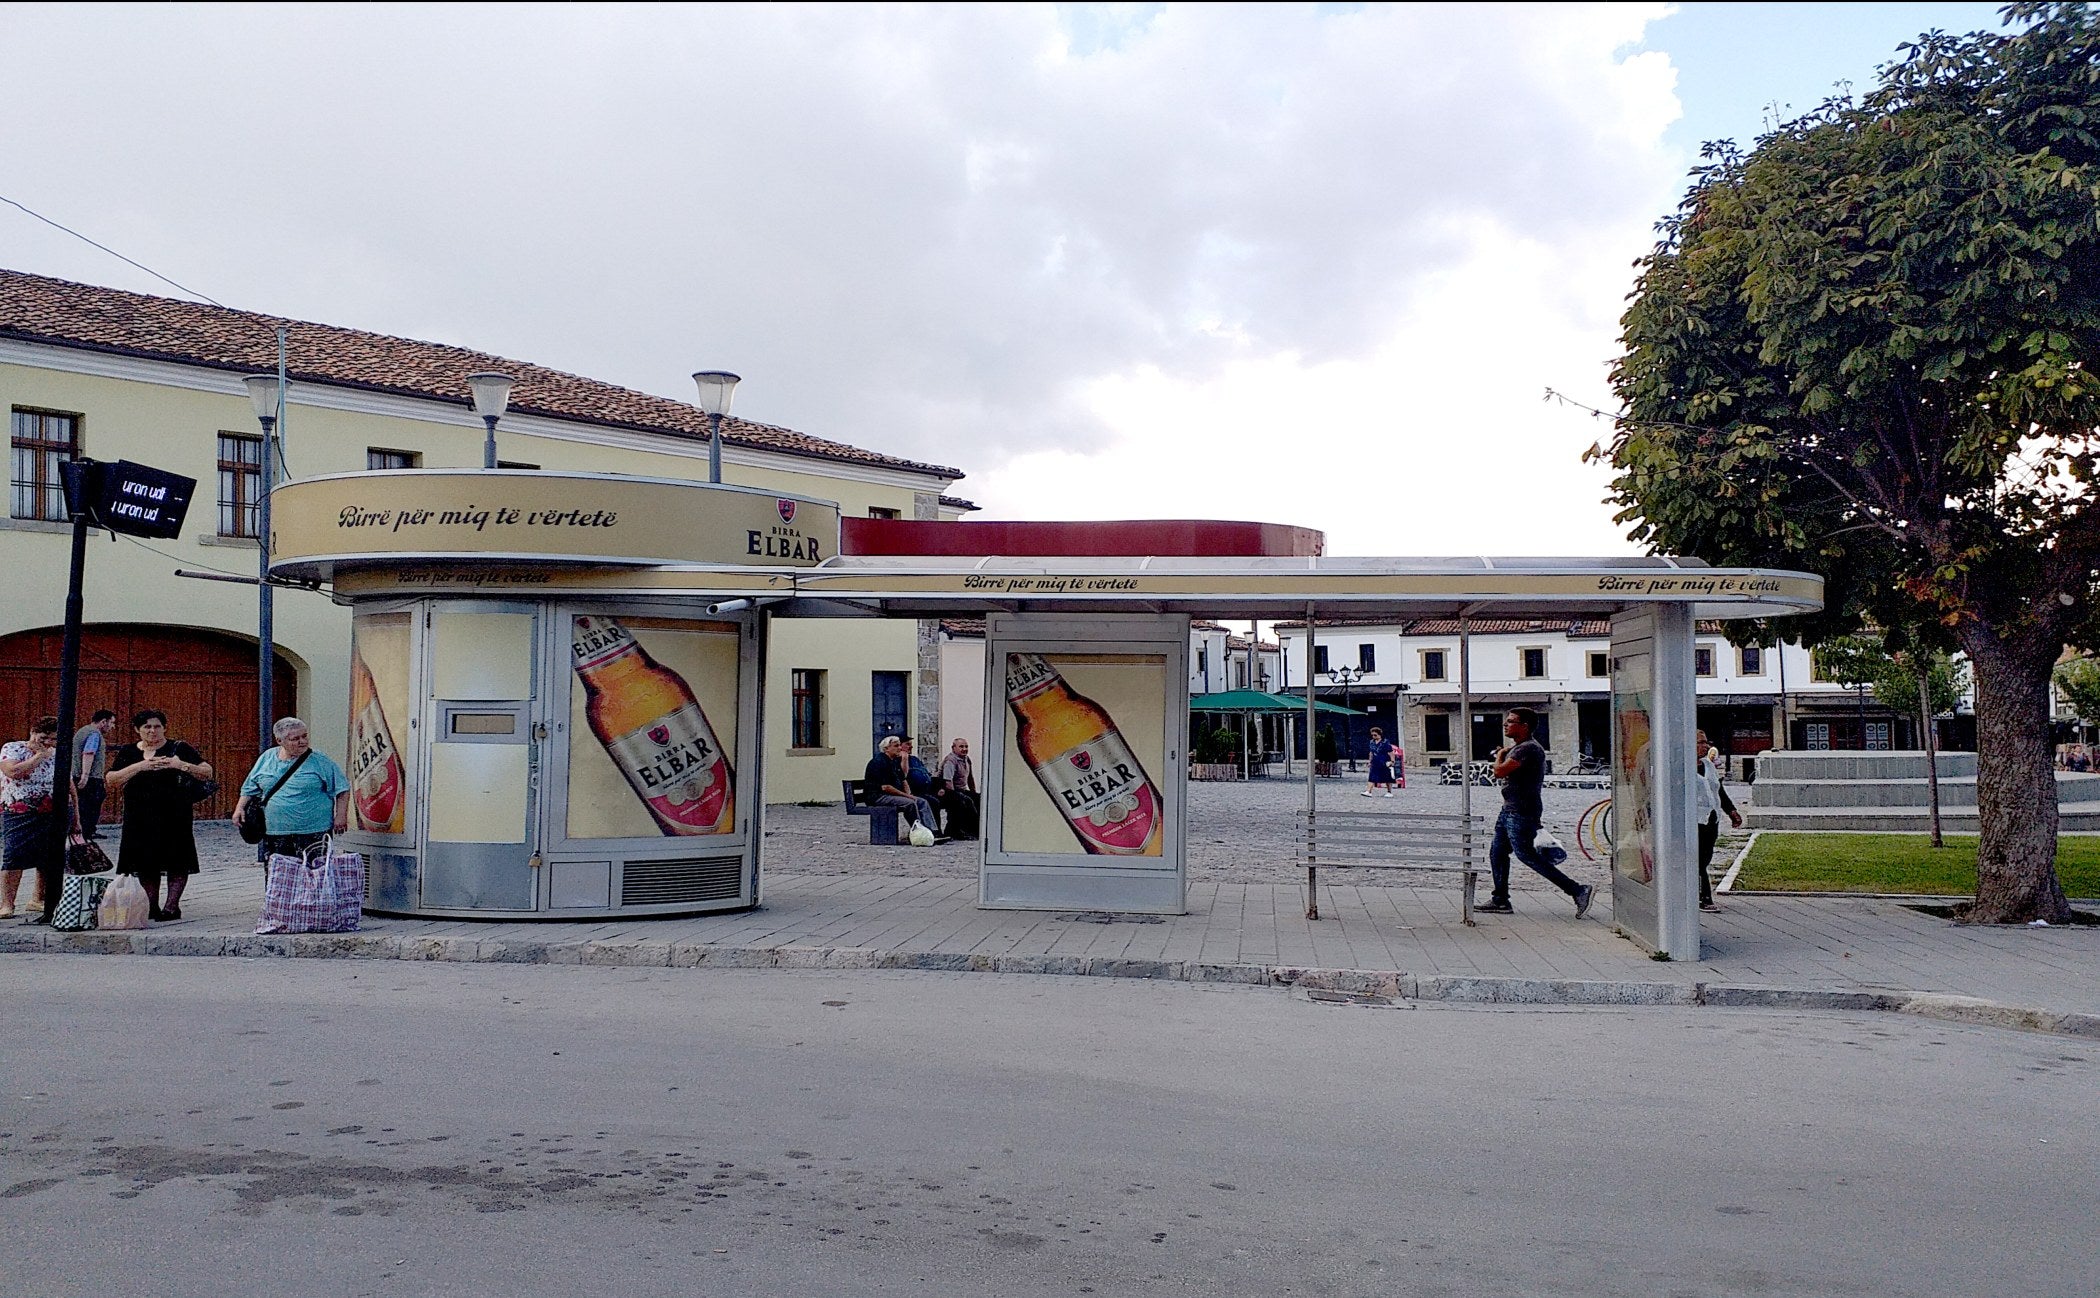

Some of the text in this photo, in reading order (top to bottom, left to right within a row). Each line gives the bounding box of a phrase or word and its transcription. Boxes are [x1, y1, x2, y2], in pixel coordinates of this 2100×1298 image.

[337, 504, 619, 533] Birrë për miq të vërtetë
[772, 526, 801, 538] BIRRA
[746, 529, 822, 563] ELBAR
[963, 574, 1139, 592] Birrë për miq të vërtetë
[1597, 576, 1645, 590] Birrë
[1647, 579, 1678, 594] për
[1681, 577, 1716, 594] miq
[1719, 579, 1735, 590] të
[572, 627, 626, 659] ELBAR
[1007, 663, 1051, 692] ELBAR
[636, 737, 713, 789] ELBAR
[655, 743, 686, 763] BIRRA
[1061, 763, 1137, 810] ELBAR
[1077, 768, 1107, 786] BIRRA
